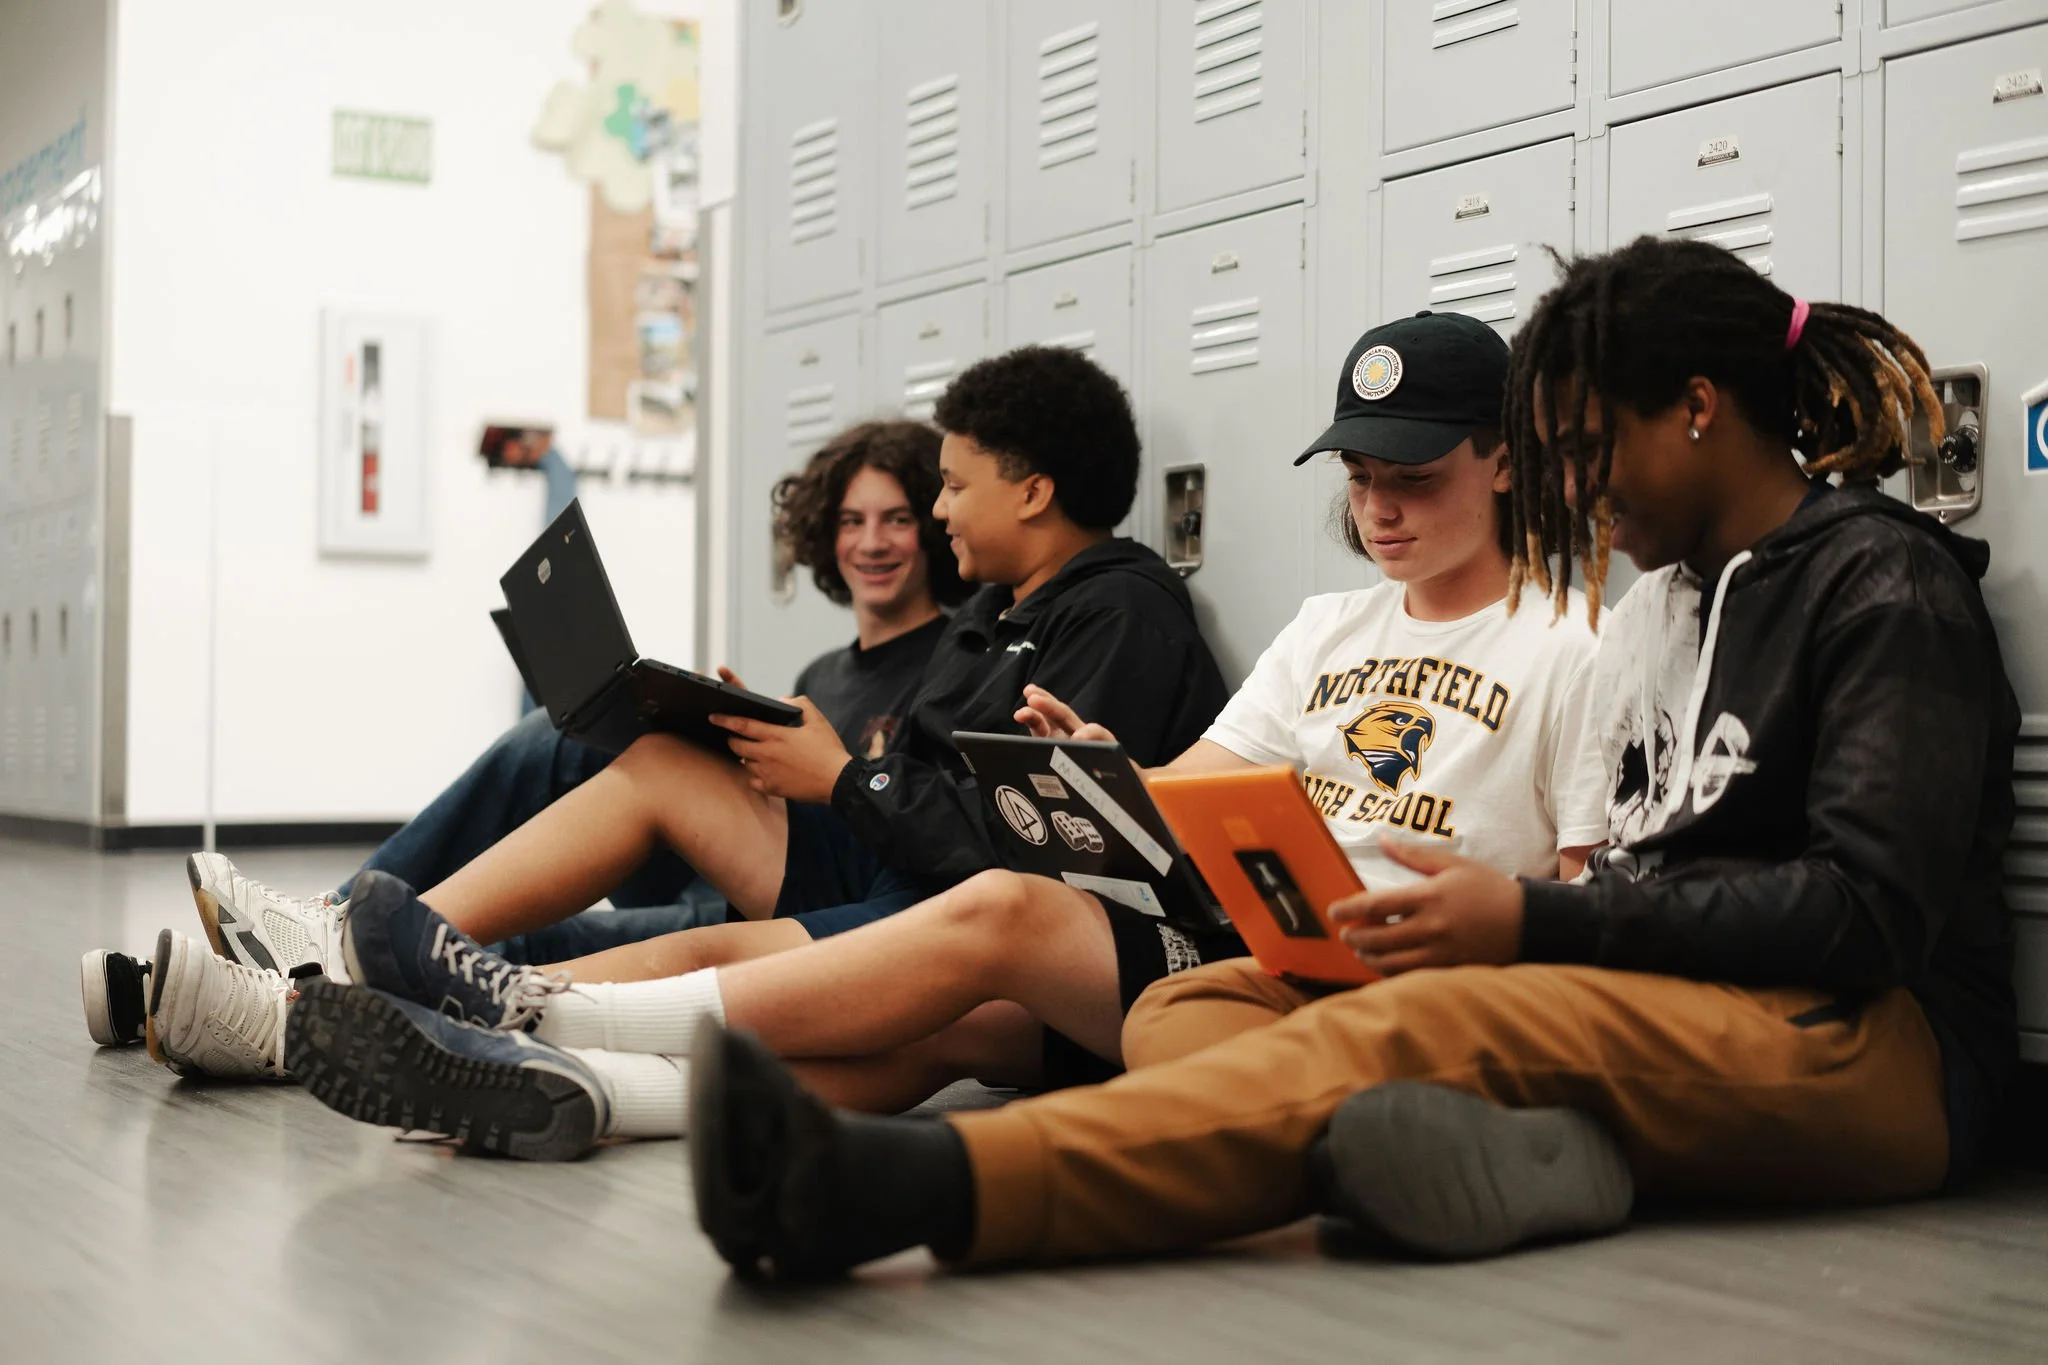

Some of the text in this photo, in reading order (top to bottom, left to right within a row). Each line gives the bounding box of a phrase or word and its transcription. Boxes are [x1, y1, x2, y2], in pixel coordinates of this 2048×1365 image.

[1708, 139, 1727, 154] 2420
[1355, 349, 1400, 377] SMITHSONIAN INSTITUTION
[1305, 656, 1510, 733] NORTHFIELD
